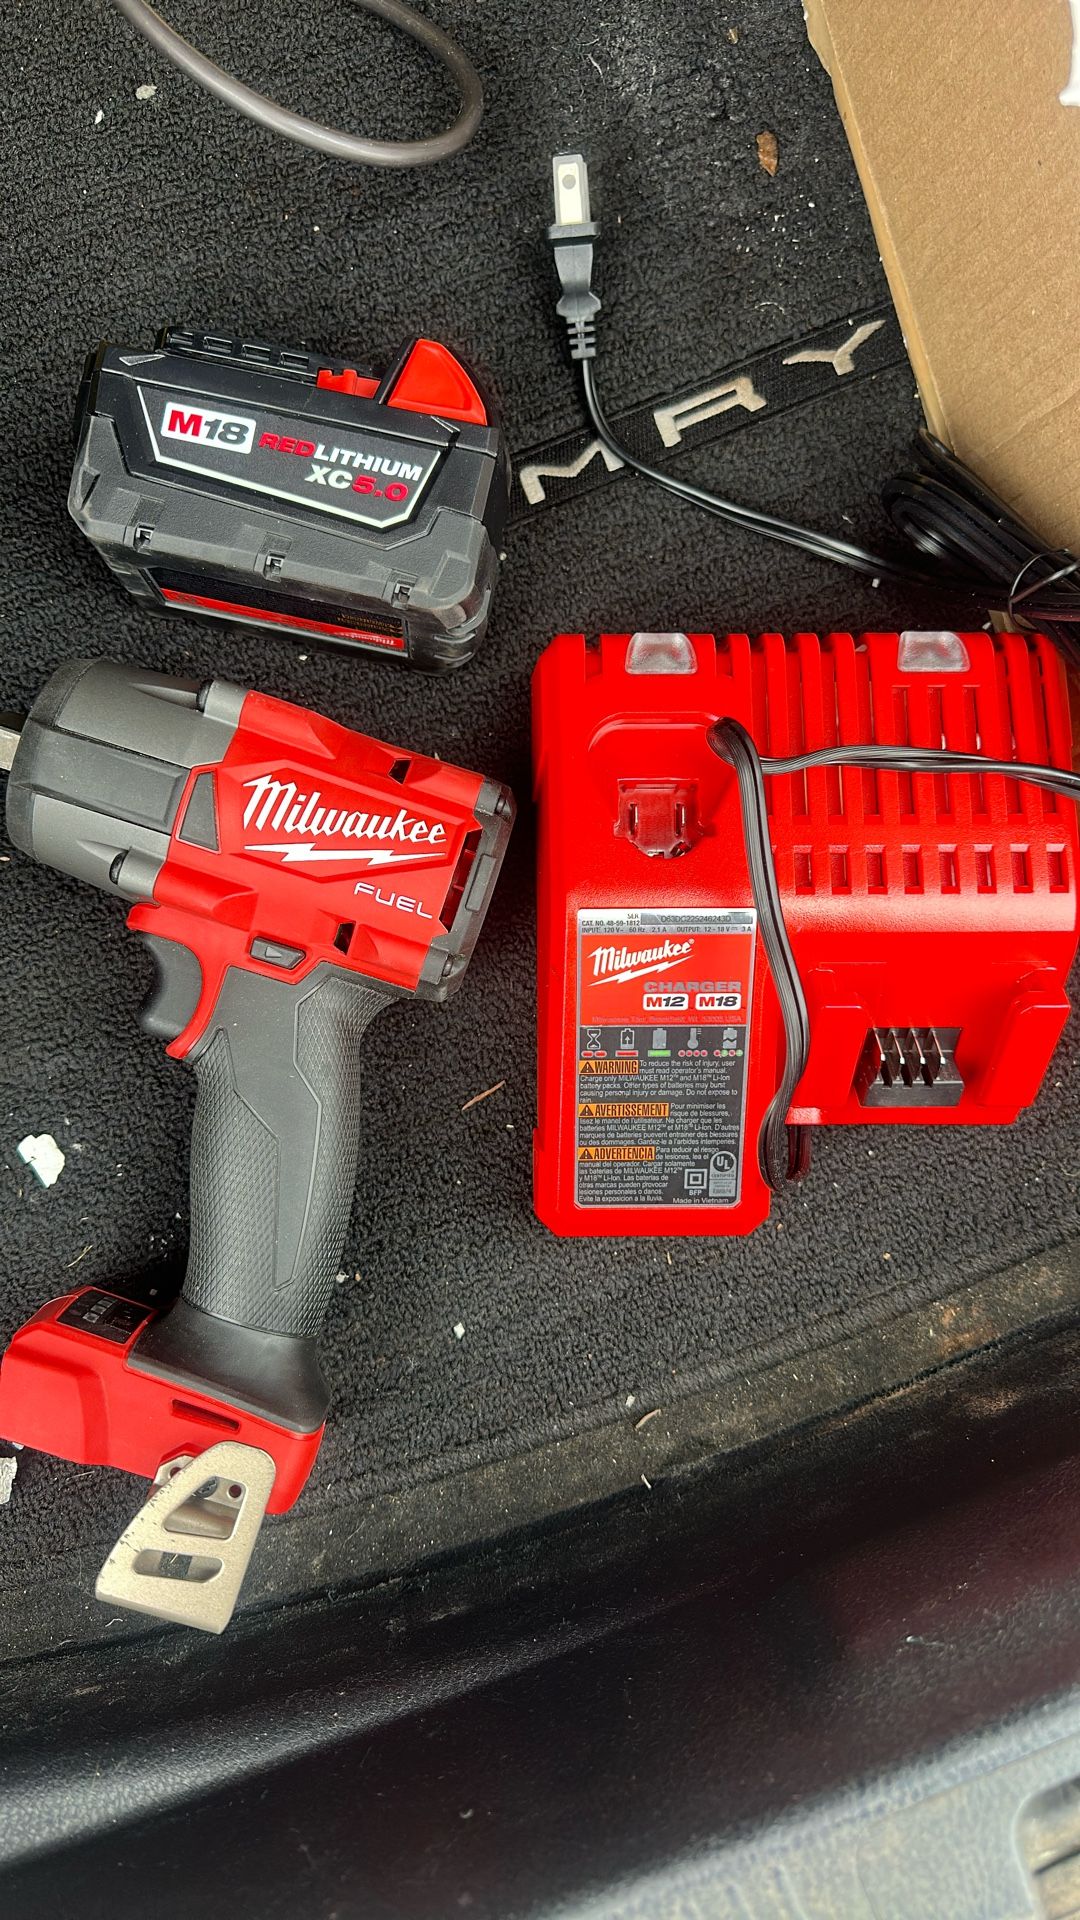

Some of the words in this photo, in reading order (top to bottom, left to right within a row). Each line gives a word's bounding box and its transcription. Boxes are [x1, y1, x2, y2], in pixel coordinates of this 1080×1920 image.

[166, 409, 249, 446] M18
[258, 431, 423, 481] REDLITHIUM
[304, 464, 409, 503] XC5.0
[242, 775, 447, 845] Milwaukee
[353, 882, 433, 919] FUEL
[588, 940, 694, 976] Milwaukee
[644, 982, 741, 992] CHARGER
[646, 996, 685, 1008] M12
[699, 996, 738, 1007] M18
[595, 1061, 637, 1073] WARNING
[595, 1104, 667, 1116] AVERTISSEMENT
[594, 1148, 652, 1159] ADVERTENCIA
[717, 1156, 730, 1170] UL
